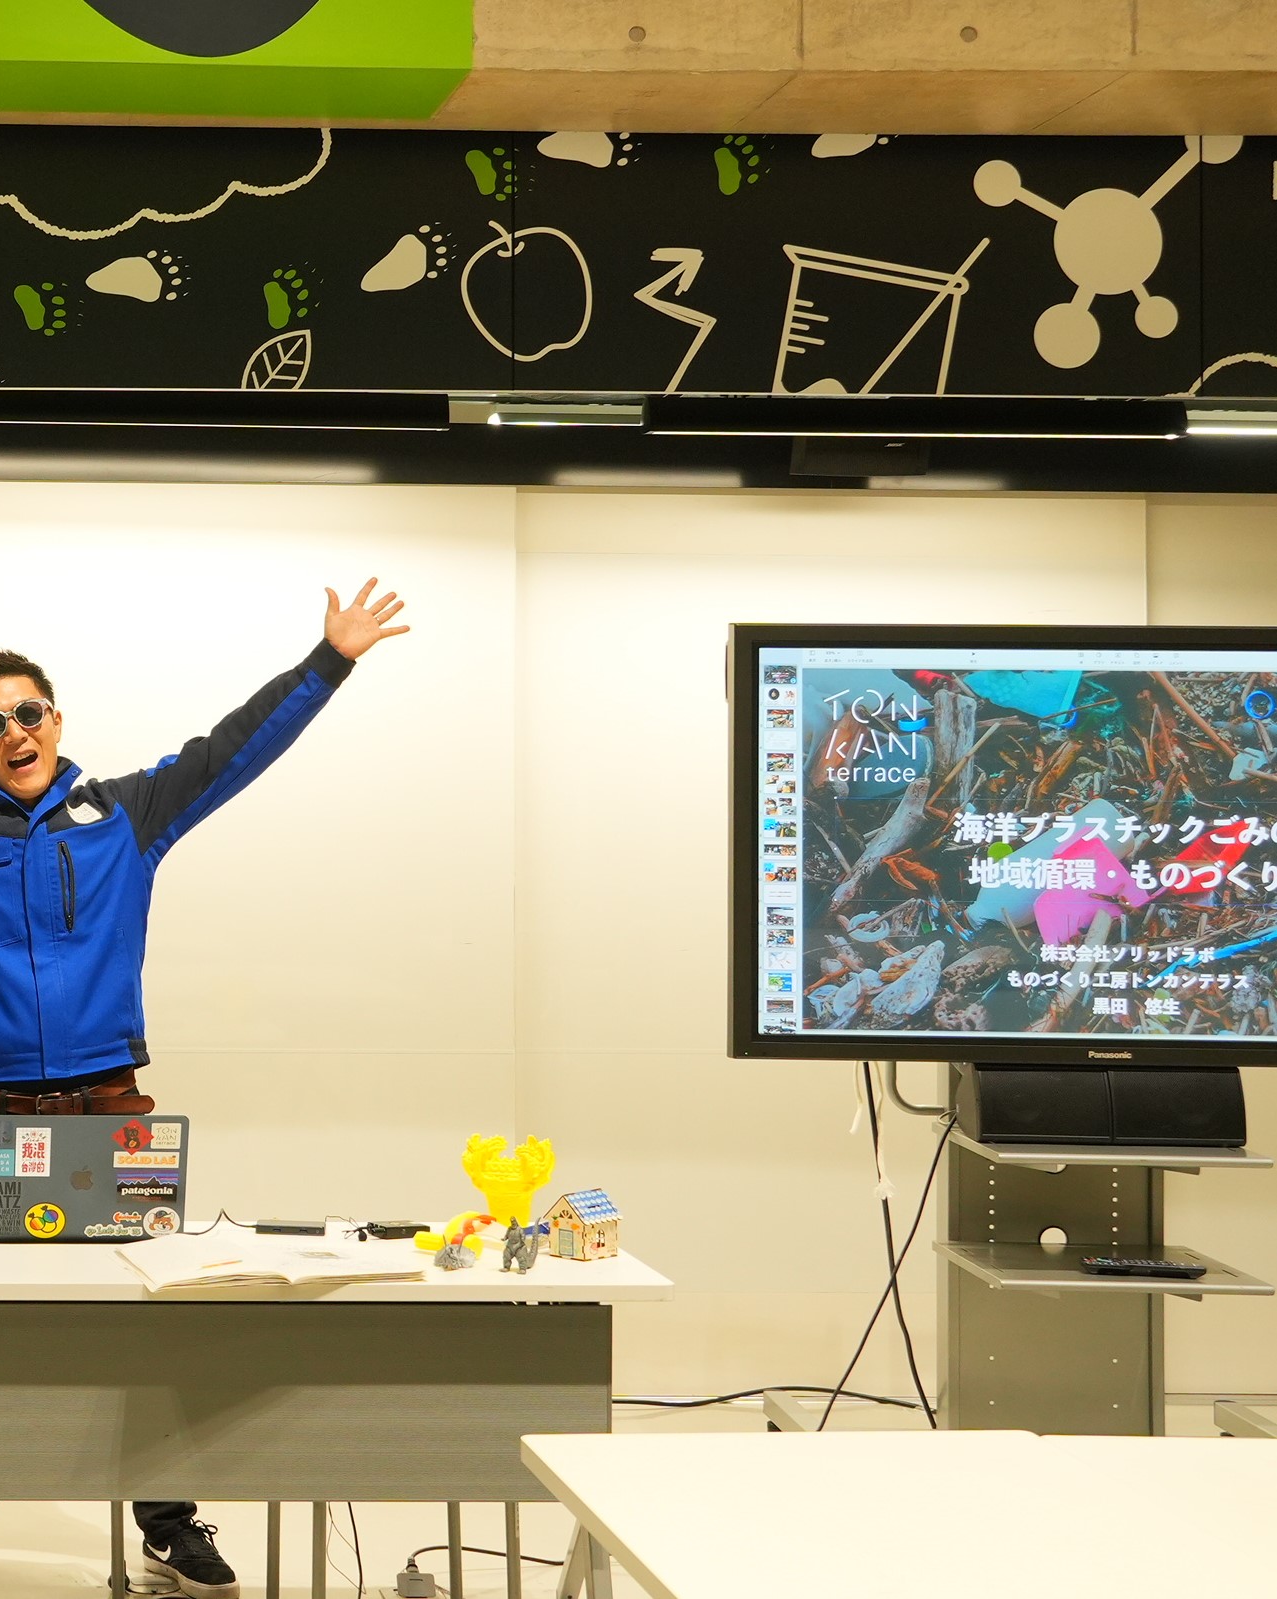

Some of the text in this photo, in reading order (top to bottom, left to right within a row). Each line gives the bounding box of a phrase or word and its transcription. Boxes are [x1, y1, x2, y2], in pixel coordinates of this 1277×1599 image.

[824, 689, 917, 724] TON
[826, 766, 916, 782] terrace
[953, 811, 1277, 846] 海洋プラスチックごみ
[1040, 944, 1215, 963] 株式会社ソリッドラボ
[1007, 970, 1250, 990] ものづくり工房トンカンテラス
[1092, 997, 1181, 1016] 黒田 悠生
[1088, 1051, 1132, 1060] Panasonic
[117, 1155, 152, 1165] SOLID
[121, 1187, 173, 1196] patagonia
